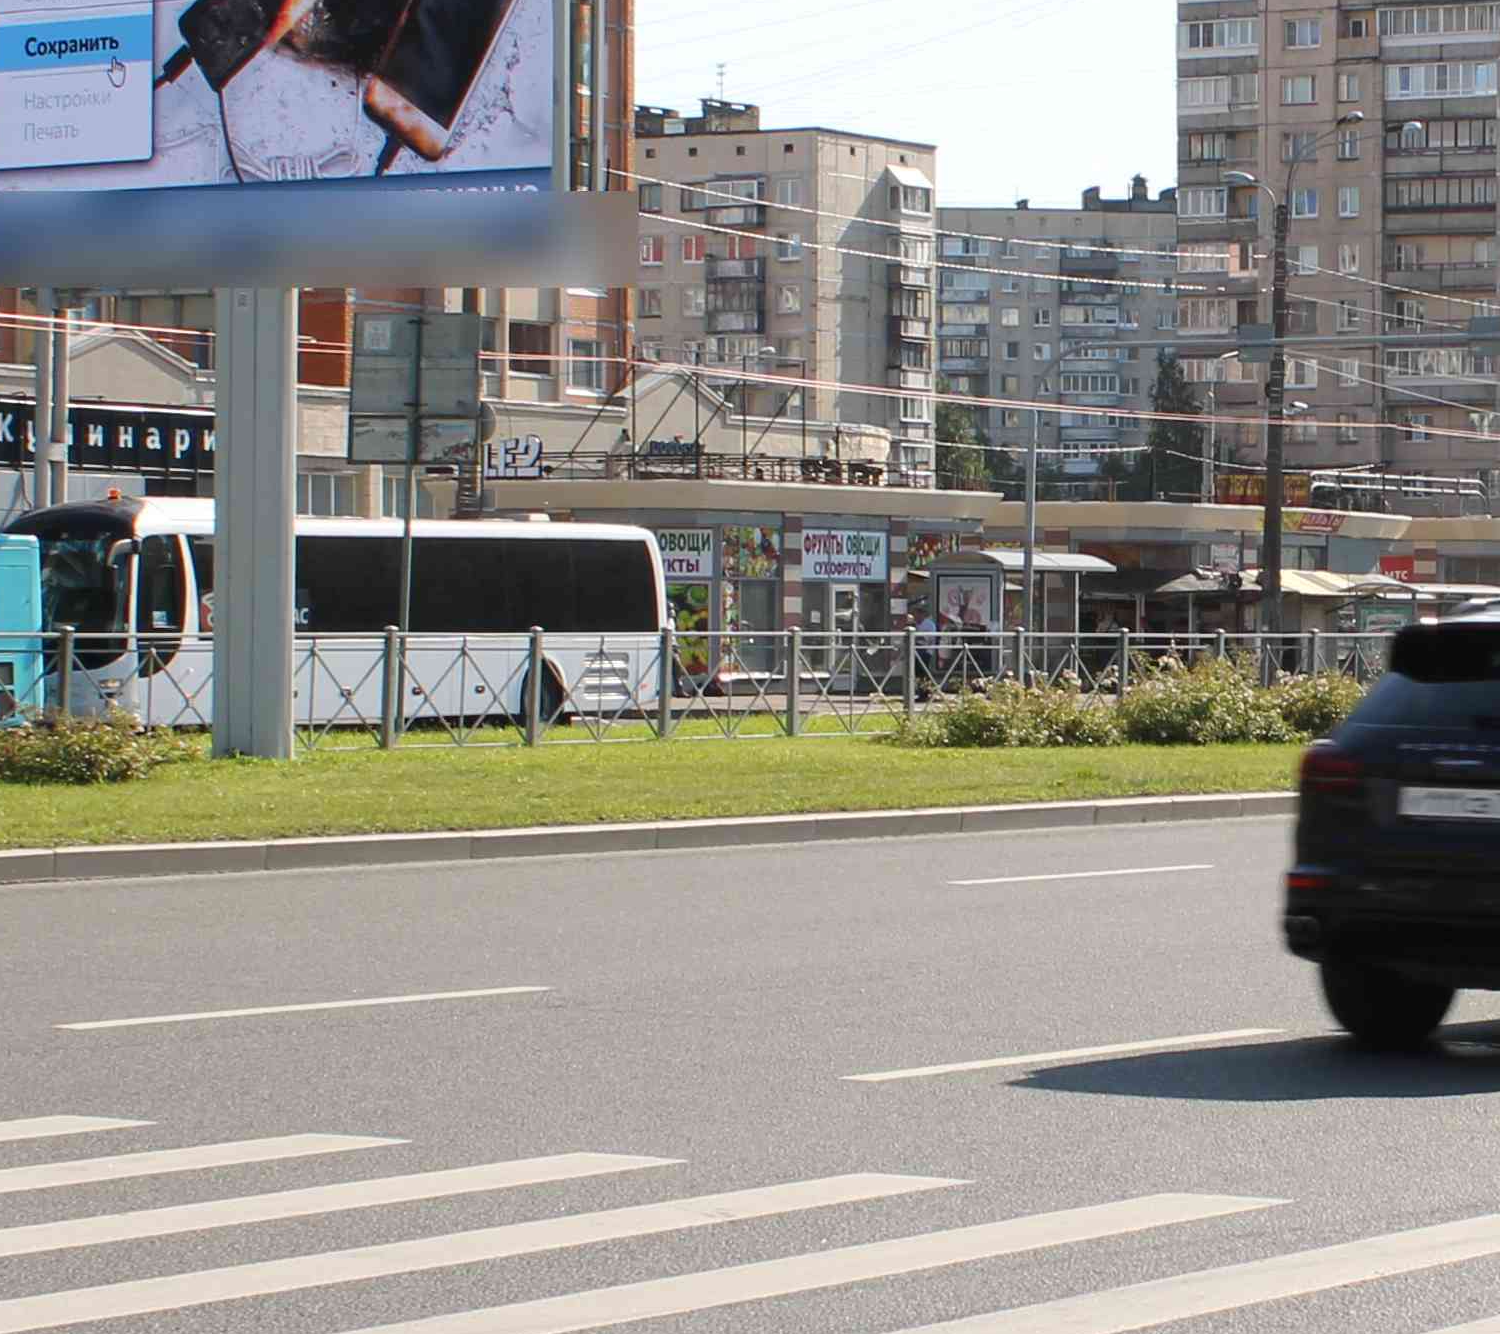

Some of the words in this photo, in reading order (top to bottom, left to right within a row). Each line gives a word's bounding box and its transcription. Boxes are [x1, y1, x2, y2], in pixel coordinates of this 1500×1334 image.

[25, 36, 119, 59] Сохранить
[24, 89, 112, 111] Настройки
[24, 122, 80, 141] Печать
[483, 434, 543, 479] LE2
[660, 533, 711, 558] ОВОЩИ
[804, 533, 844, 556] ФРУКТЫ
[846, 534, 882, 559] ОВОЩИ
[663, 559, 699, 574] КТЫ
[813, 561, 872, 576] СУХОФРУКТЫ
